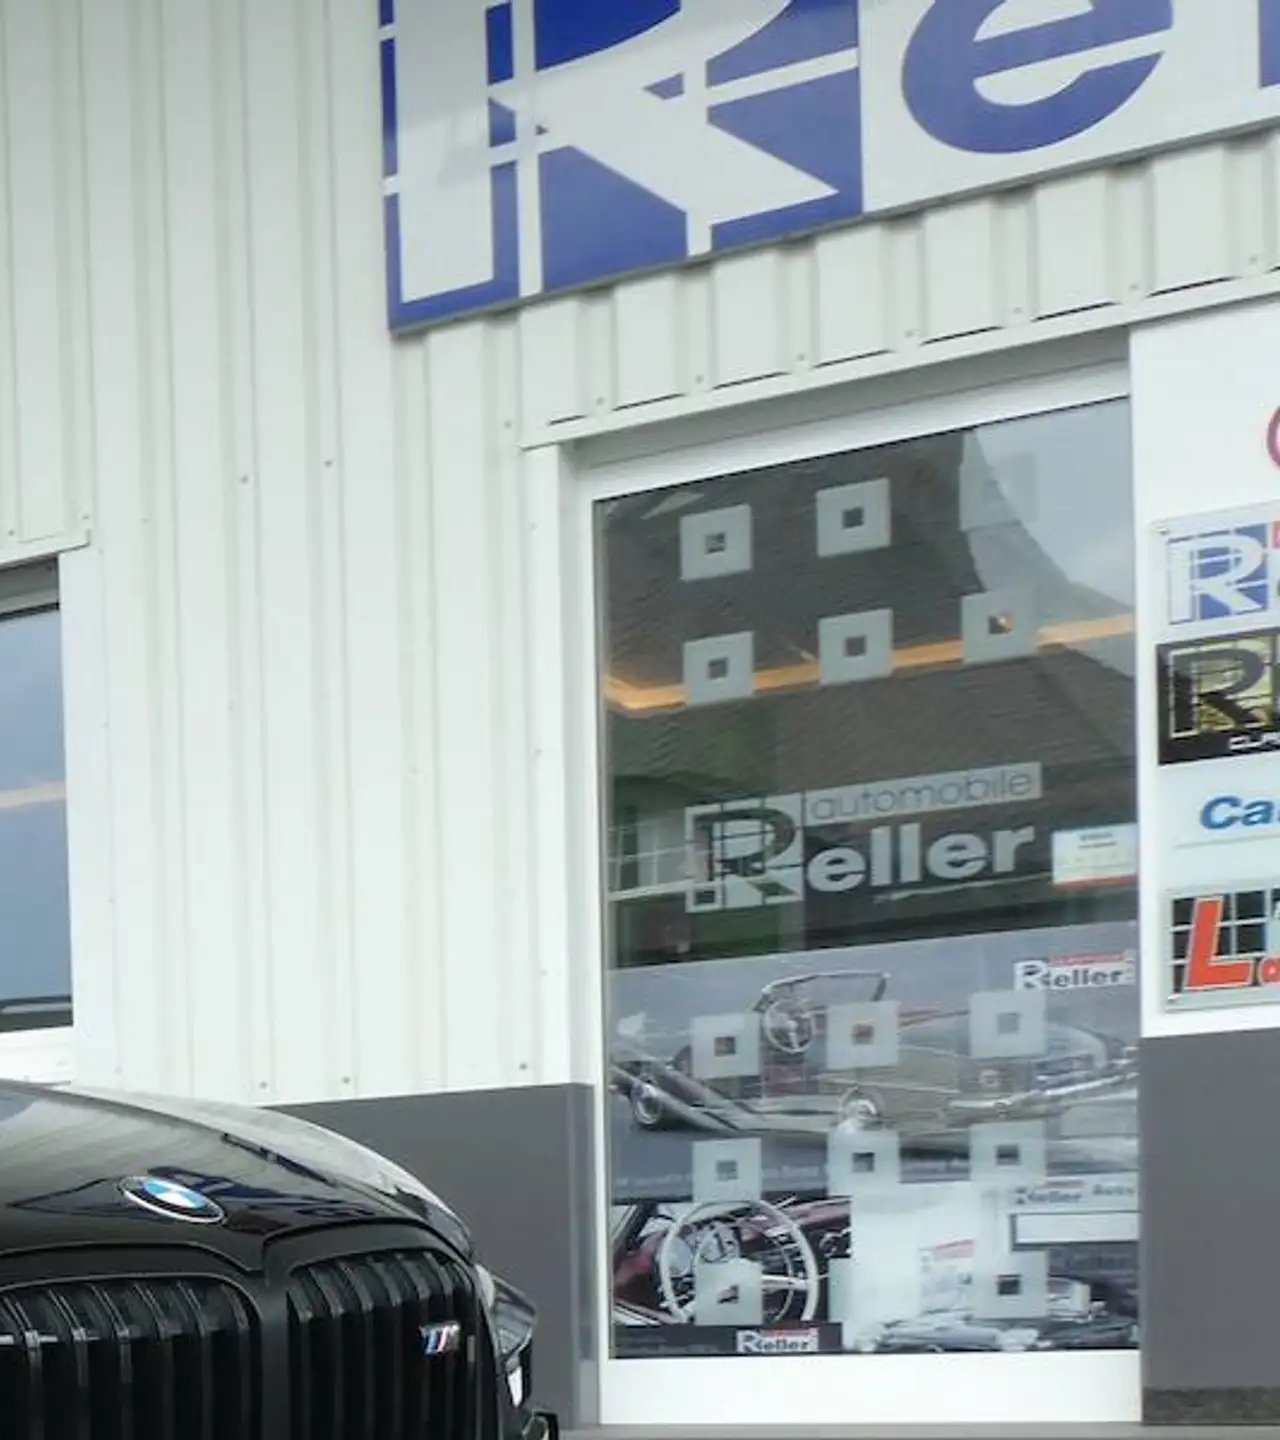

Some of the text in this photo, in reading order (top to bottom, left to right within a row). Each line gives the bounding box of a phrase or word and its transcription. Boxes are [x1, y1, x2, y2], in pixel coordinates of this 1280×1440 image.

[395, 0, 1280, 305] Re
[1167, 530, 1280, 623] R
[809, 768, 1033, 820] automobile
[686, 793, 1036, 912] Reller
